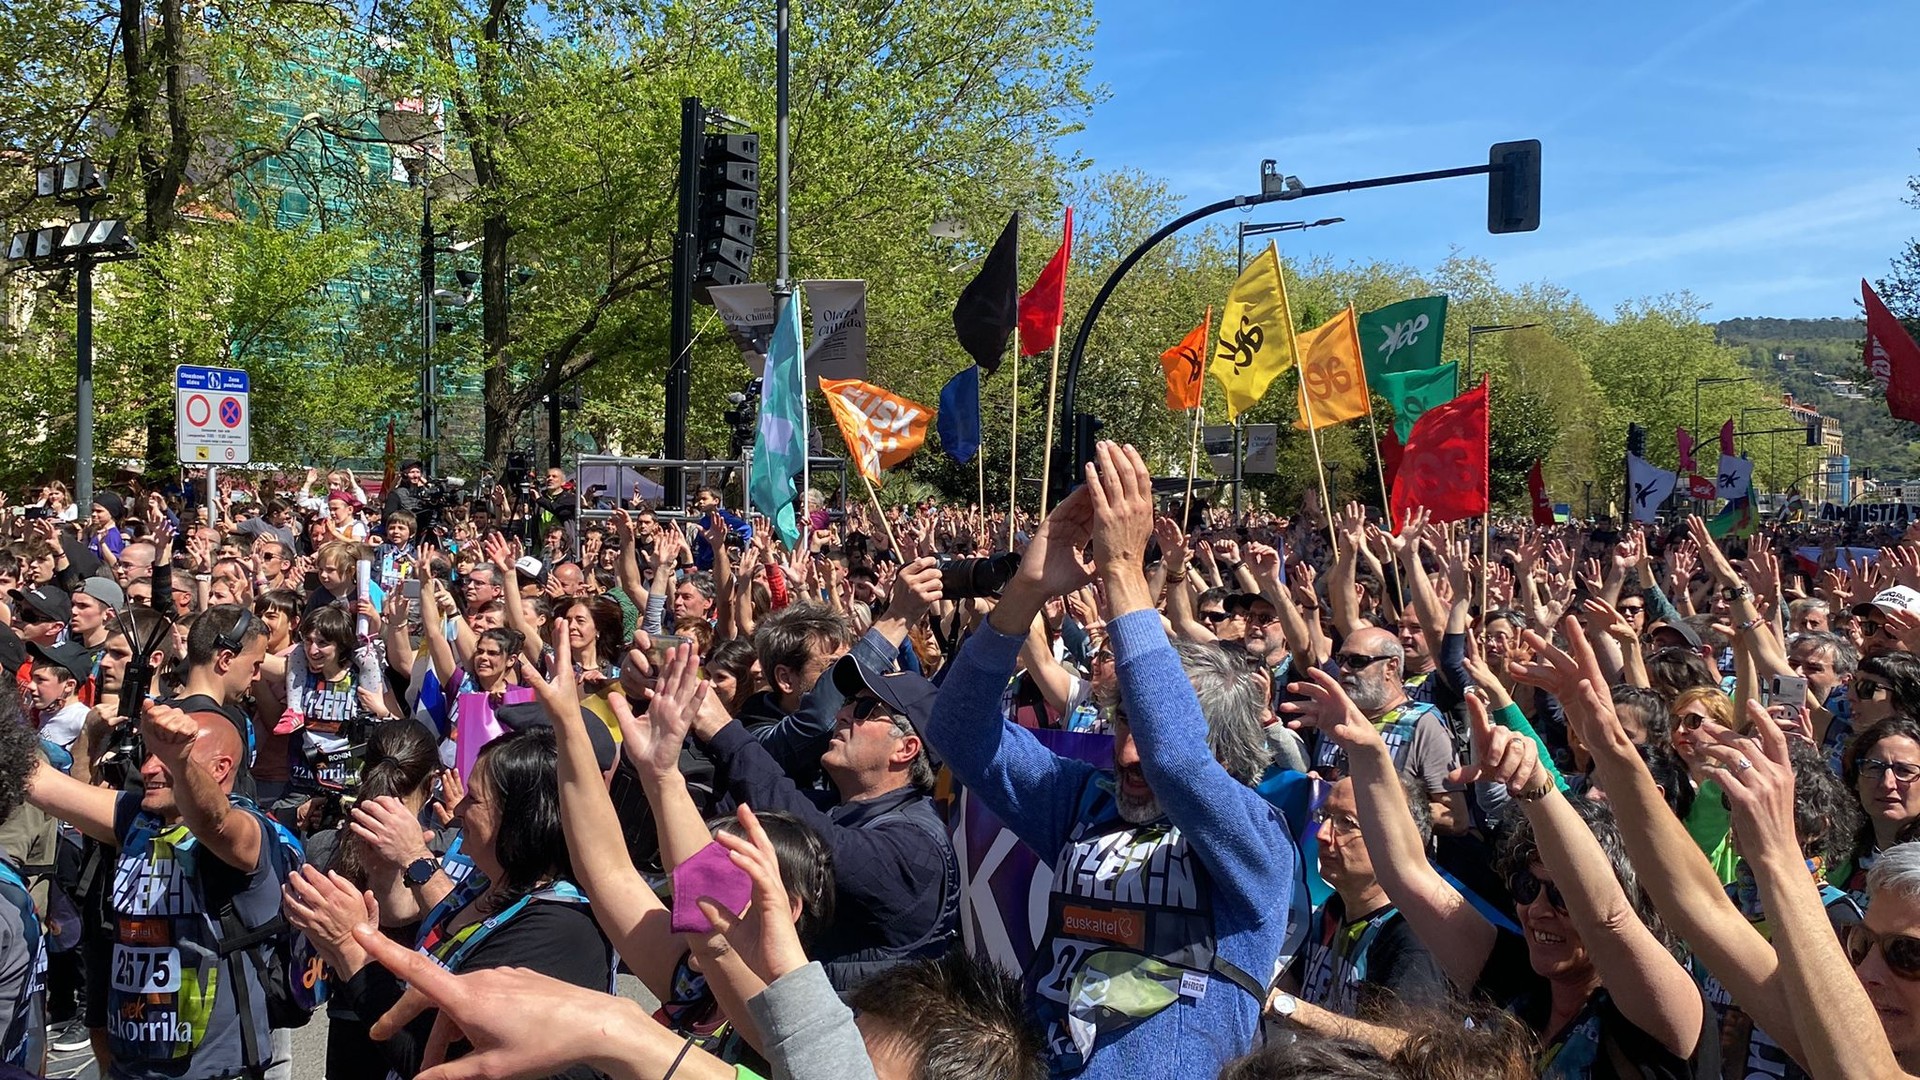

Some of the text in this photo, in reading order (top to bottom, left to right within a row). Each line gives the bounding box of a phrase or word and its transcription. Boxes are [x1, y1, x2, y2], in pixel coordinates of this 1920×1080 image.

[328, 750, 352, 762] RONIN
[1065, 917, 1118, 936] euskaltel
[116, 949, 171, 989] 2575
